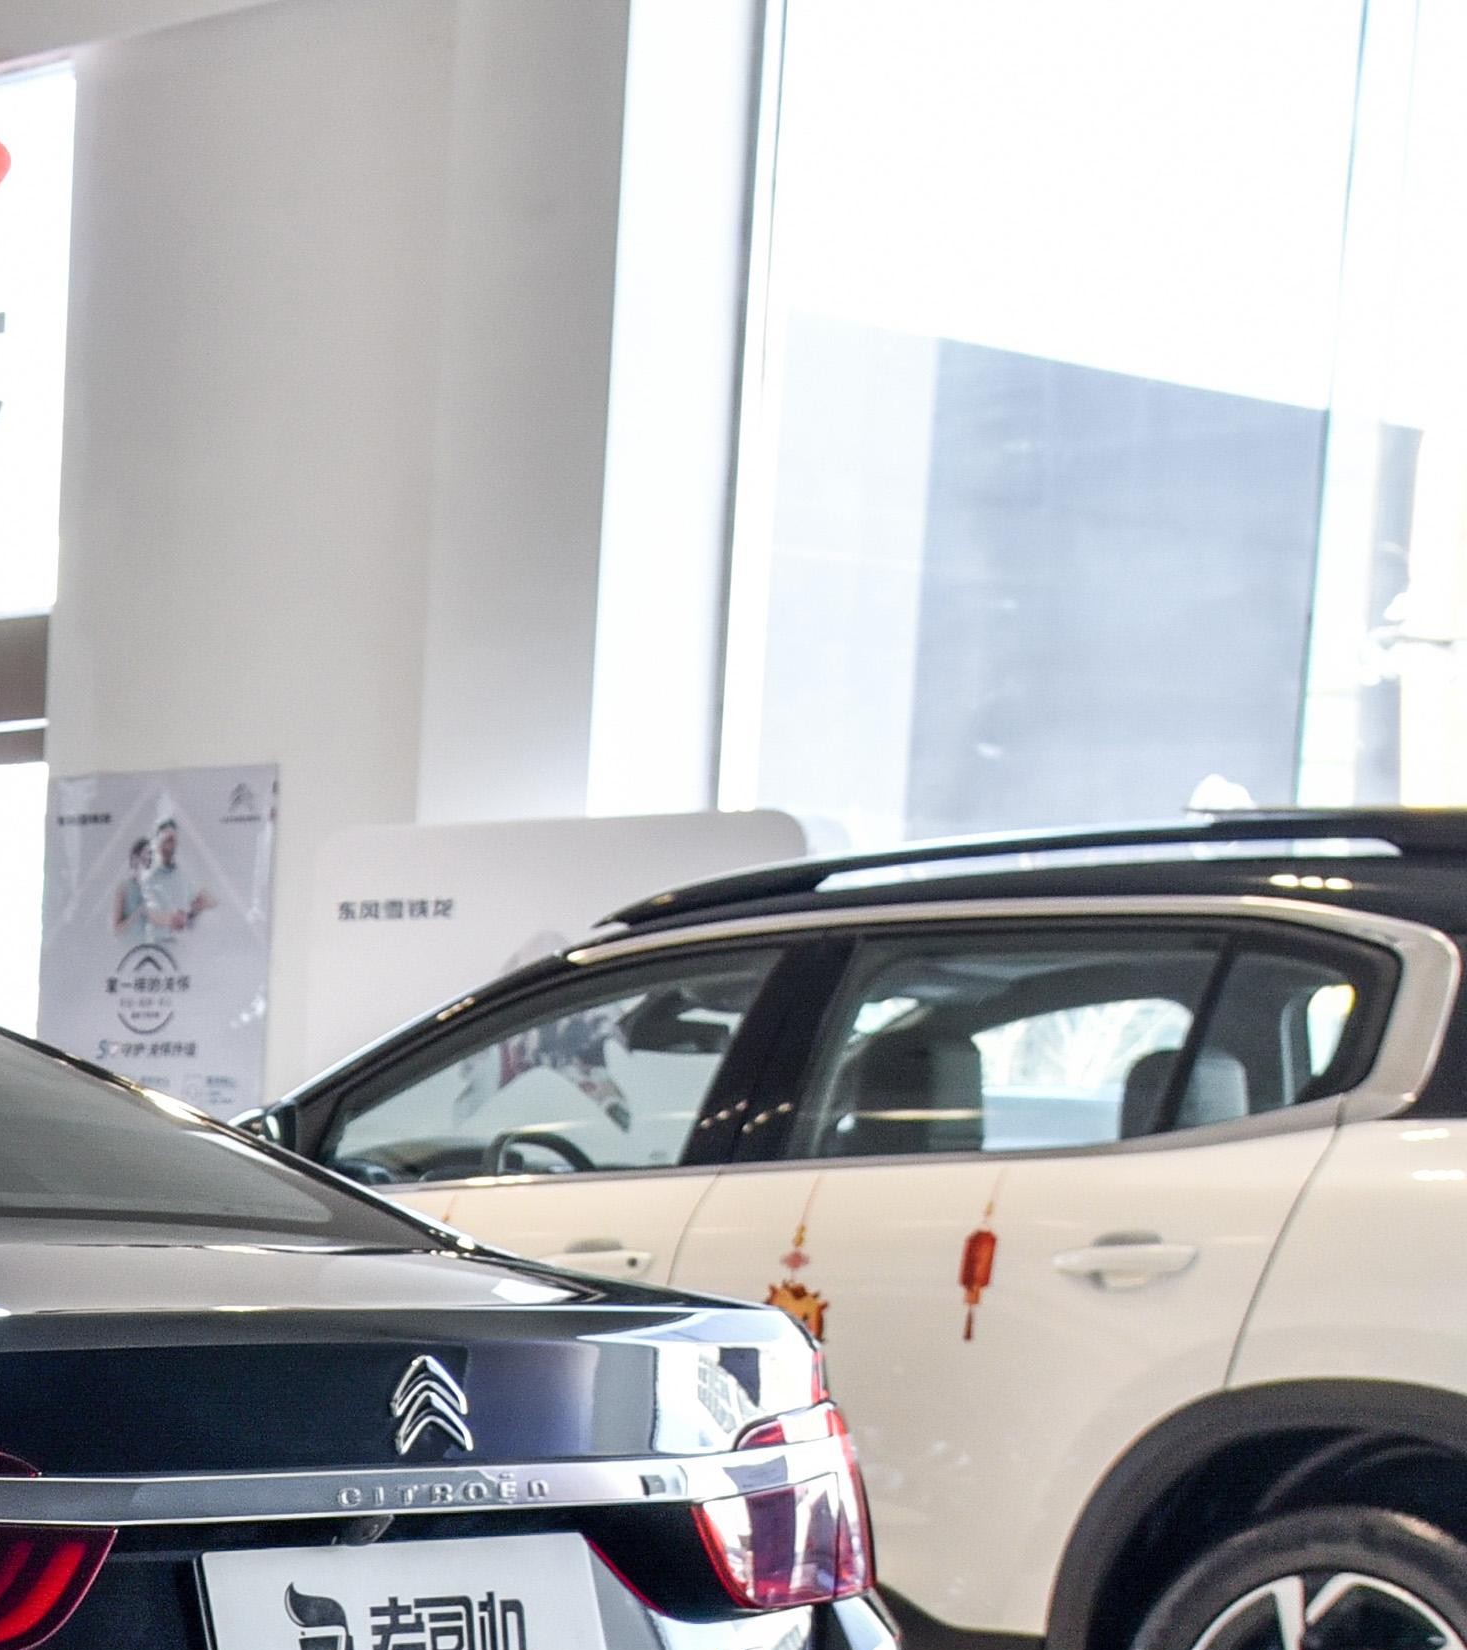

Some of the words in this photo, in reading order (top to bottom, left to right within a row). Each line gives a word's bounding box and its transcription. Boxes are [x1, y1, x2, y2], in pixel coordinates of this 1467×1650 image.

[337, 898, 454, 921] 东风雪铁龙
